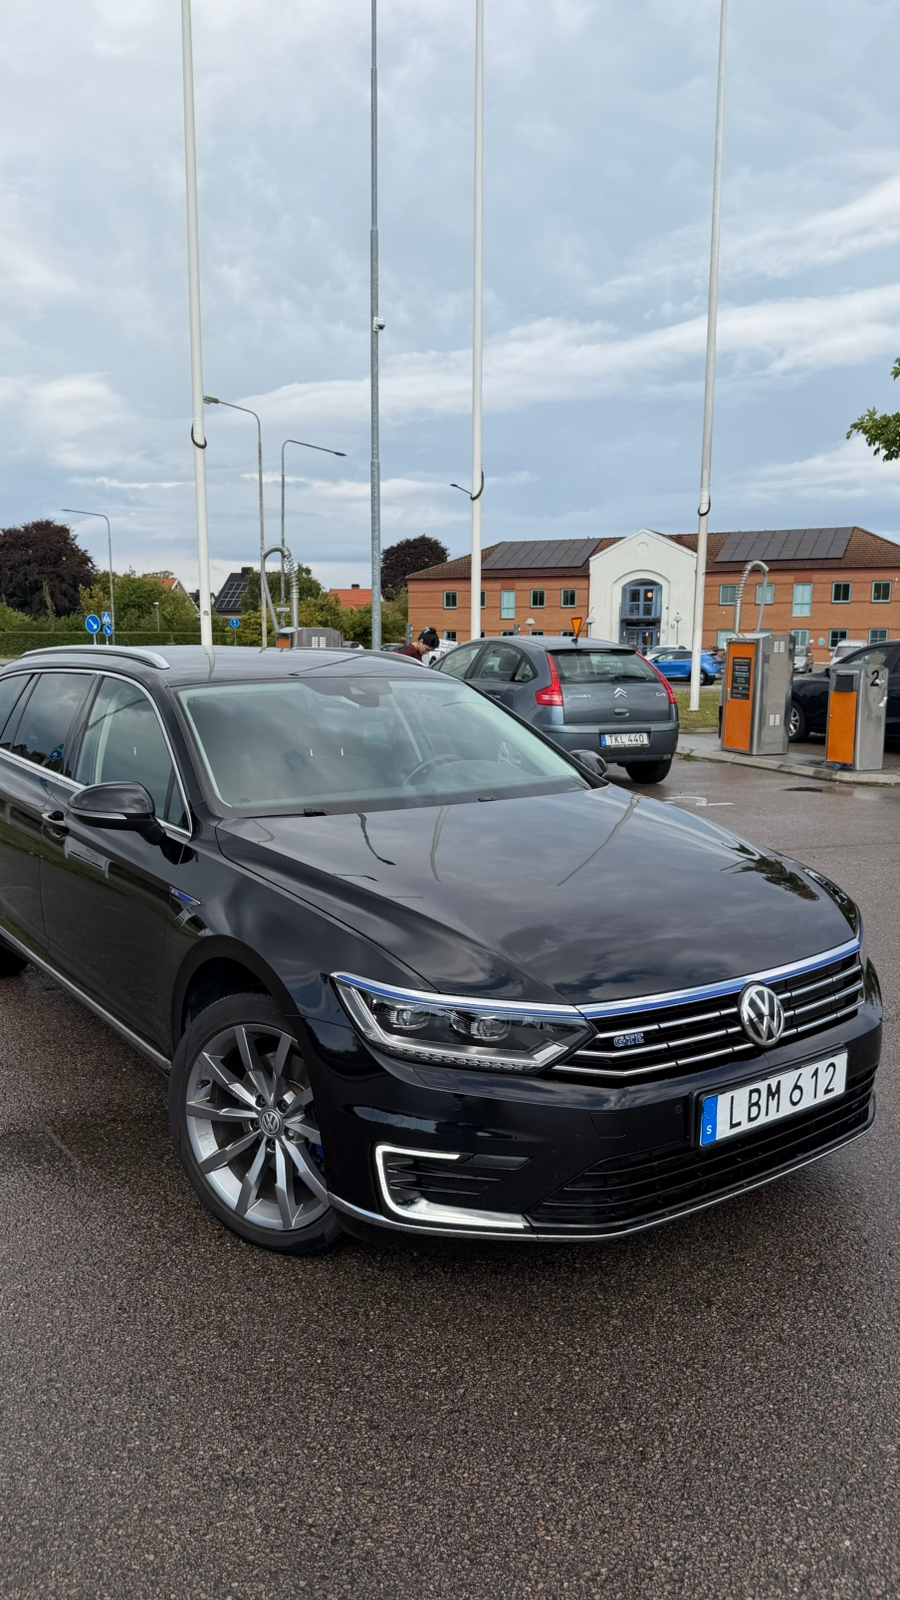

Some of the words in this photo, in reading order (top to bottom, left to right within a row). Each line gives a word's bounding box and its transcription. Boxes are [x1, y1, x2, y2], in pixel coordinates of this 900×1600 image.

[870, 669, 880, 687] 2
[608, 734, 626, 744] TKL
[628, 733, 645, 743] 440
[613, 1032, 645, 1048] GTE
[706, 1124, 713, 1136] S
[729, 1079, 782, 1131] LBM
[789, 1062, 837, 1107] 612
